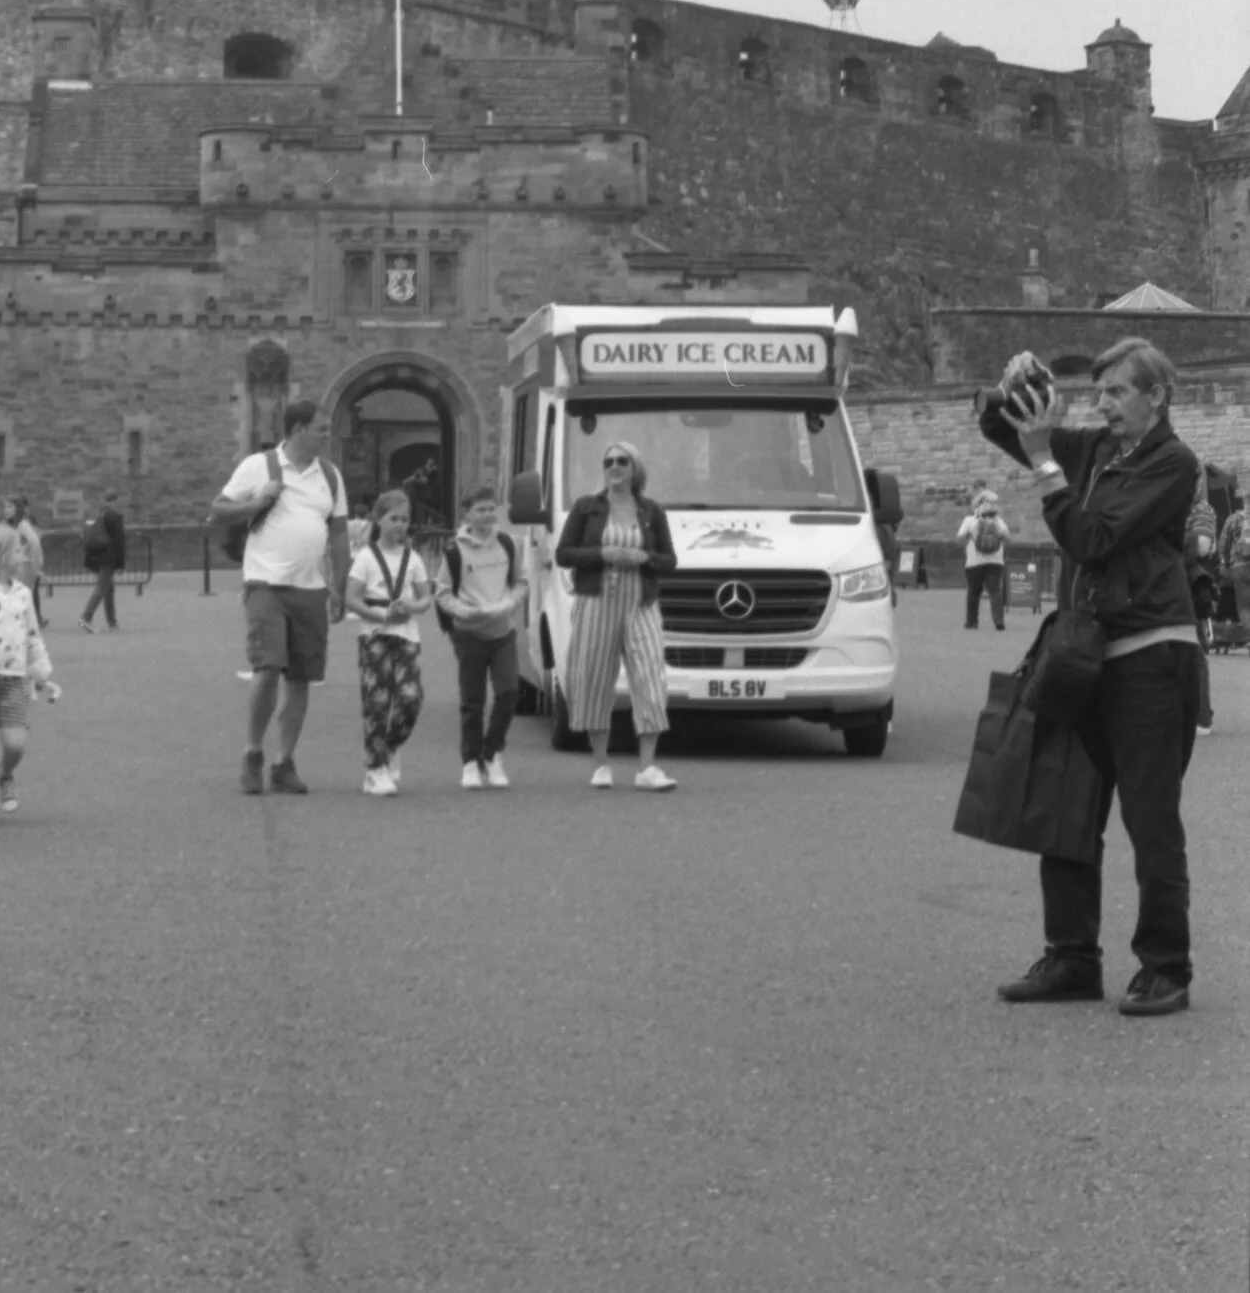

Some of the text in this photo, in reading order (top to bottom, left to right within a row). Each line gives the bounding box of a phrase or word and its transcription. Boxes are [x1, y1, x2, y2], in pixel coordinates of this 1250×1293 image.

[593, 342, 815, 364] DAIRY ICE CREAM
[708, 679, 766, 697] BLS 8V
